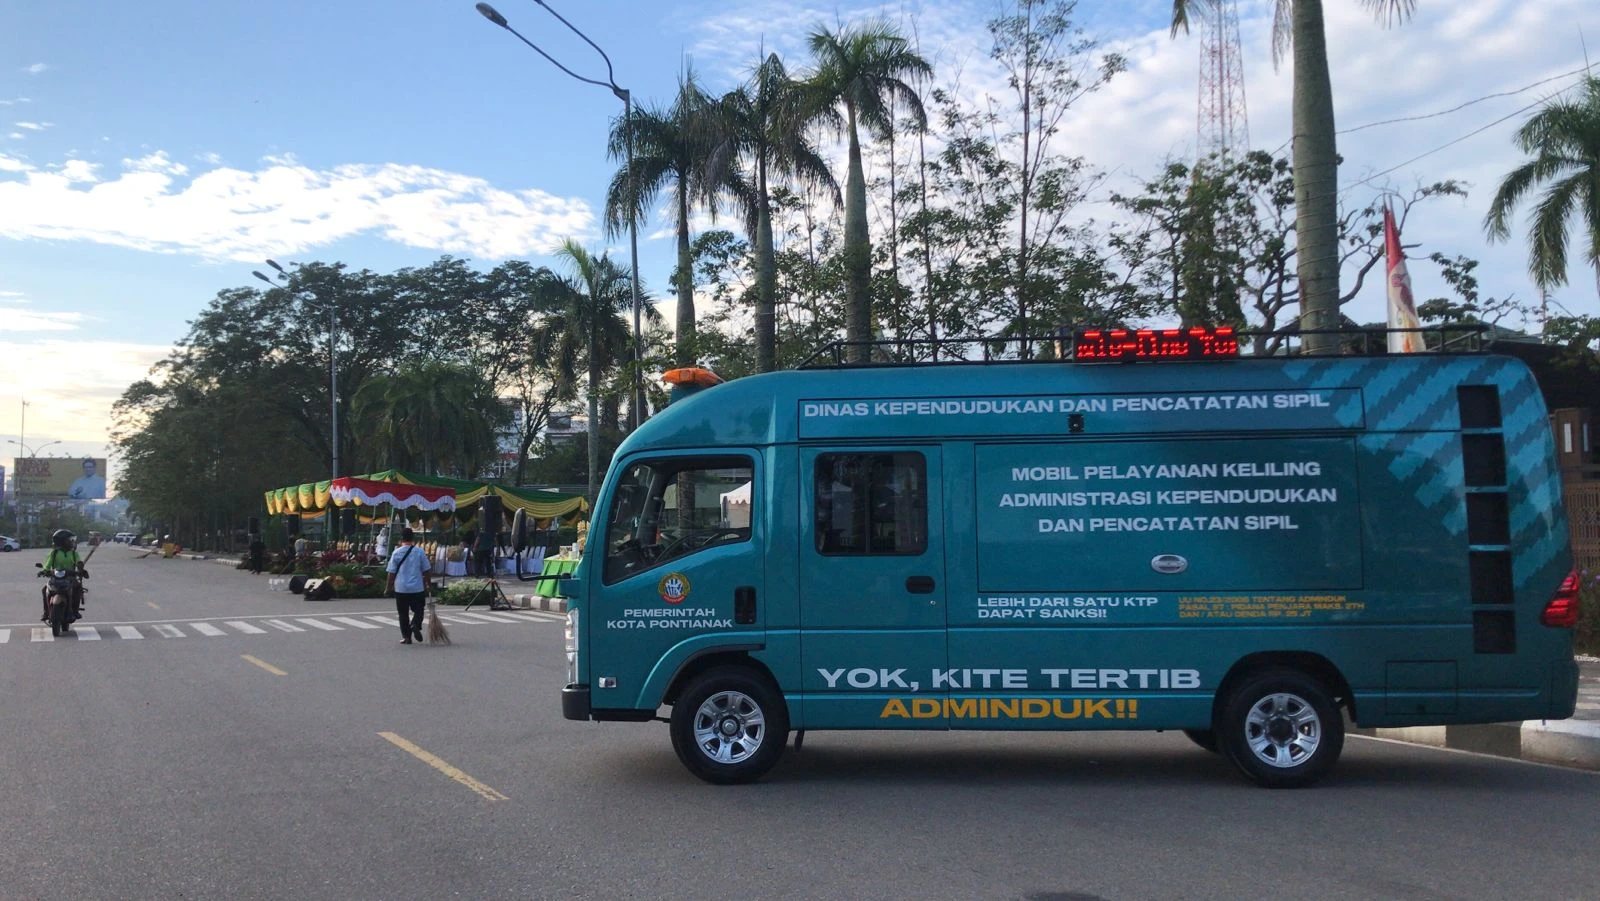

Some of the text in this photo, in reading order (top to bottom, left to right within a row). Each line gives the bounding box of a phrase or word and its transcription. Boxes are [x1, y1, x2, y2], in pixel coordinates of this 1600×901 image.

[804, 393, 1331, 417] DINAS KEPENDUDUKAN DAN PENCATATAN SIPIL
[1011, 461, 1322, 482] MOBIL PELAYANAN KELILING
[999, 487, 1338, 508] ADMINISTRASI KEPENDUDUKAN
[1038, 515, 1299, 534] DAN PENCATATAN SIPIL
[977, 596, 1159, 608] LEBIH DARI SATU KTP
[1298, 595, 1346, 603] ADMINDUK
[623, 607, 715, 618] PEMERINTAH
[977, 608, 1036, 619] DAPAT
[1179, 610, 1201, 618] DAN
[1208, 610, 1233, 618] ATAU
[606, 618, 733, 629] KOTA PONTIANAK
[816, 667, 1202, 692] YOK, KITE TERTIB
[880, 698, 1139, 719] ADMINDUK!!
